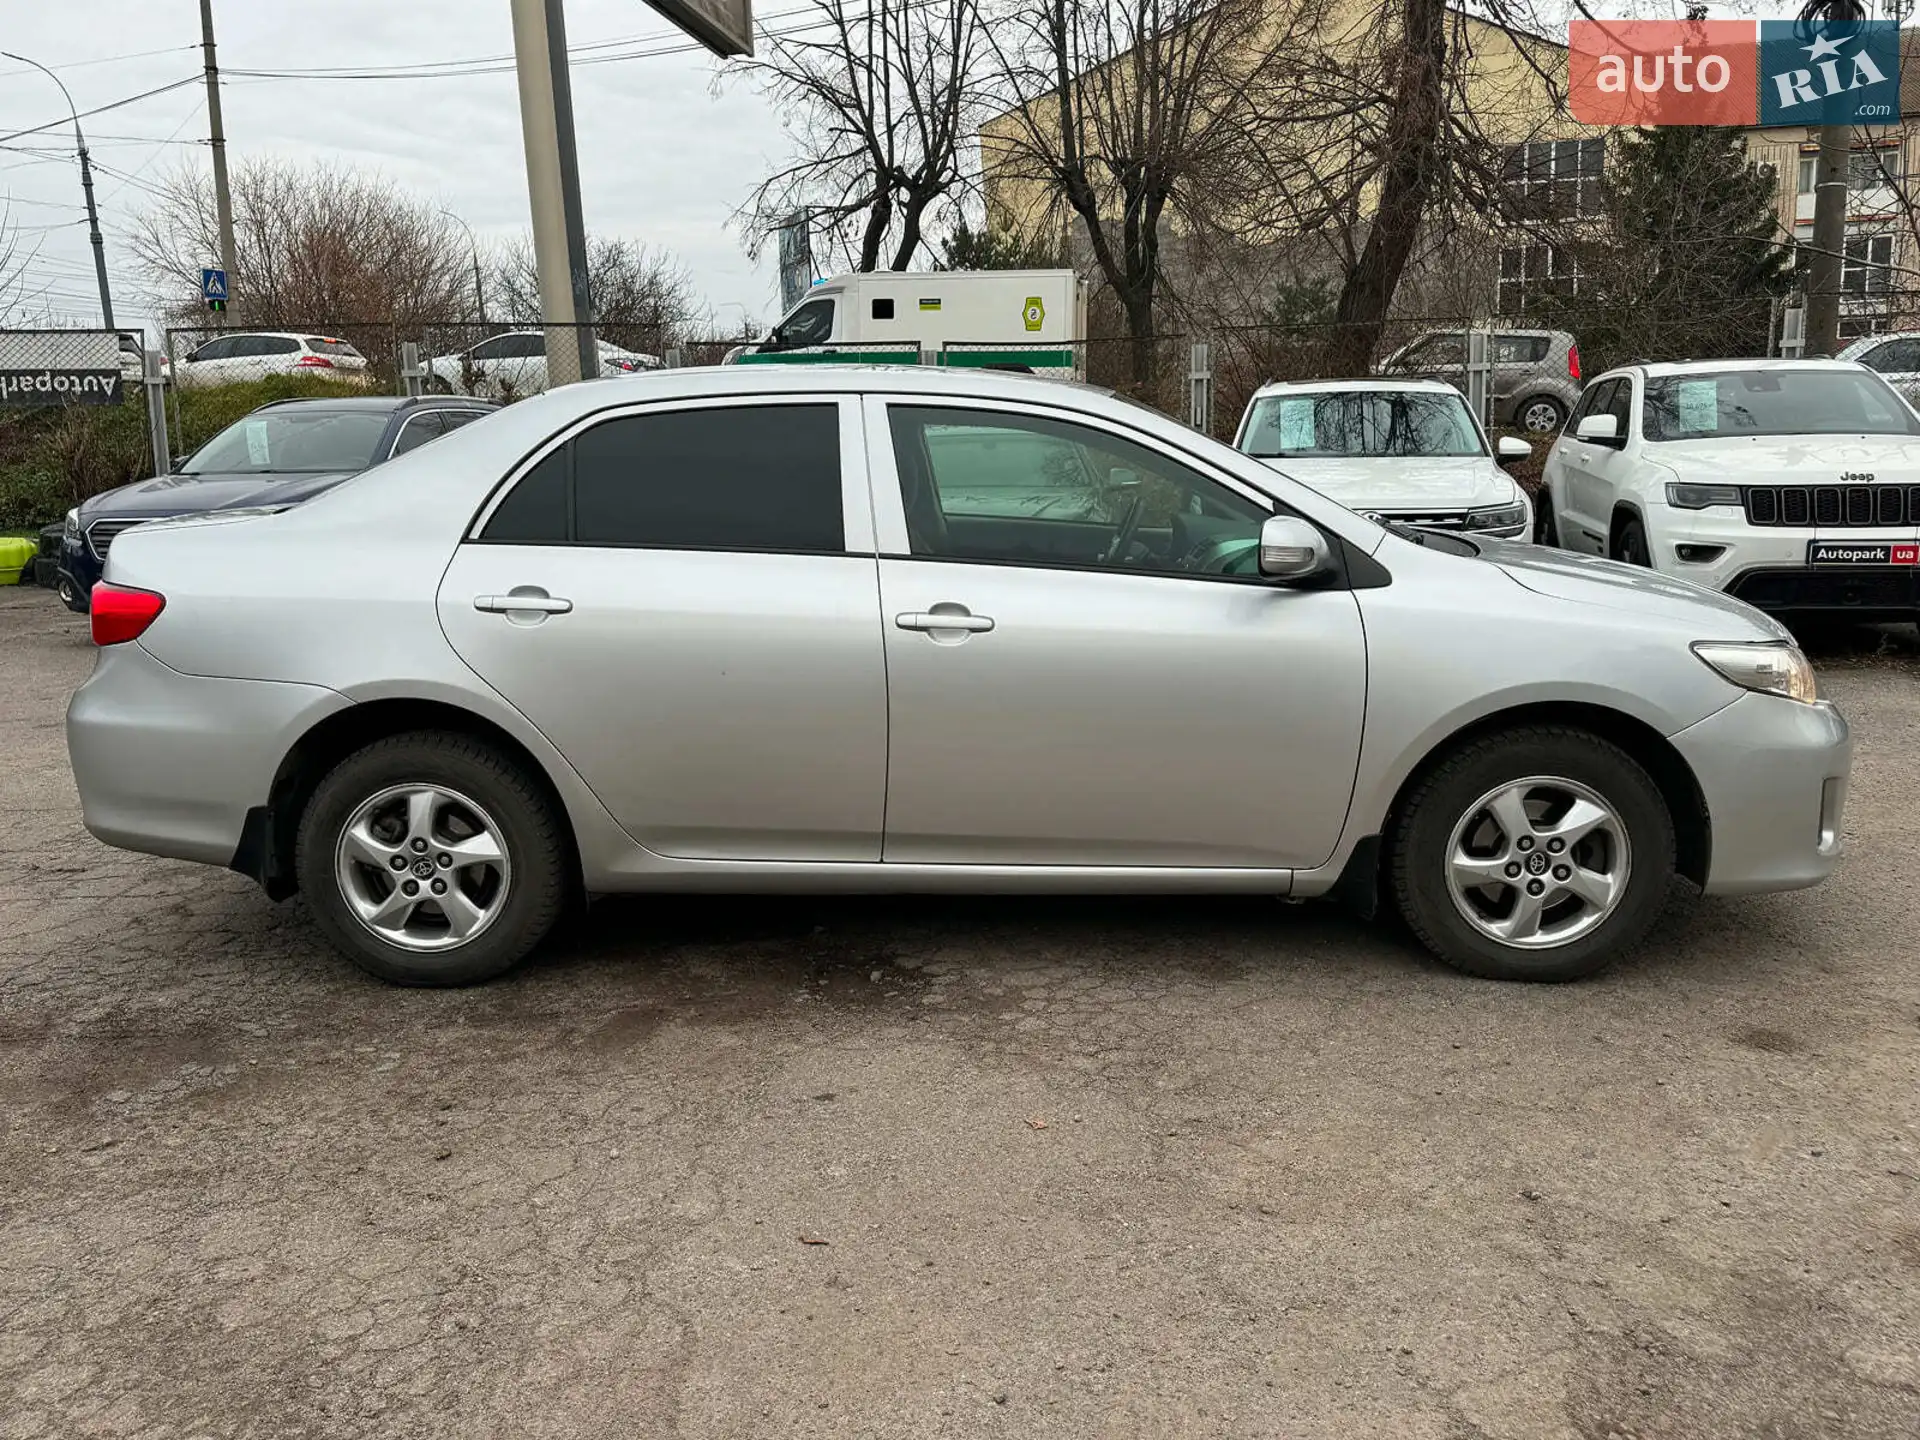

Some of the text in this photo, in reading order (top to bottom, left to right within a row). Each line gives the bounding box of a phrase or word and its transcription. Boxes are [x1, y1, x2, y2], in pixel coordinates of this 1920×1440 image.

[1840, 471, 1876, 483] Jeep
[1816, 548, 1915, 562] Autopark ua
